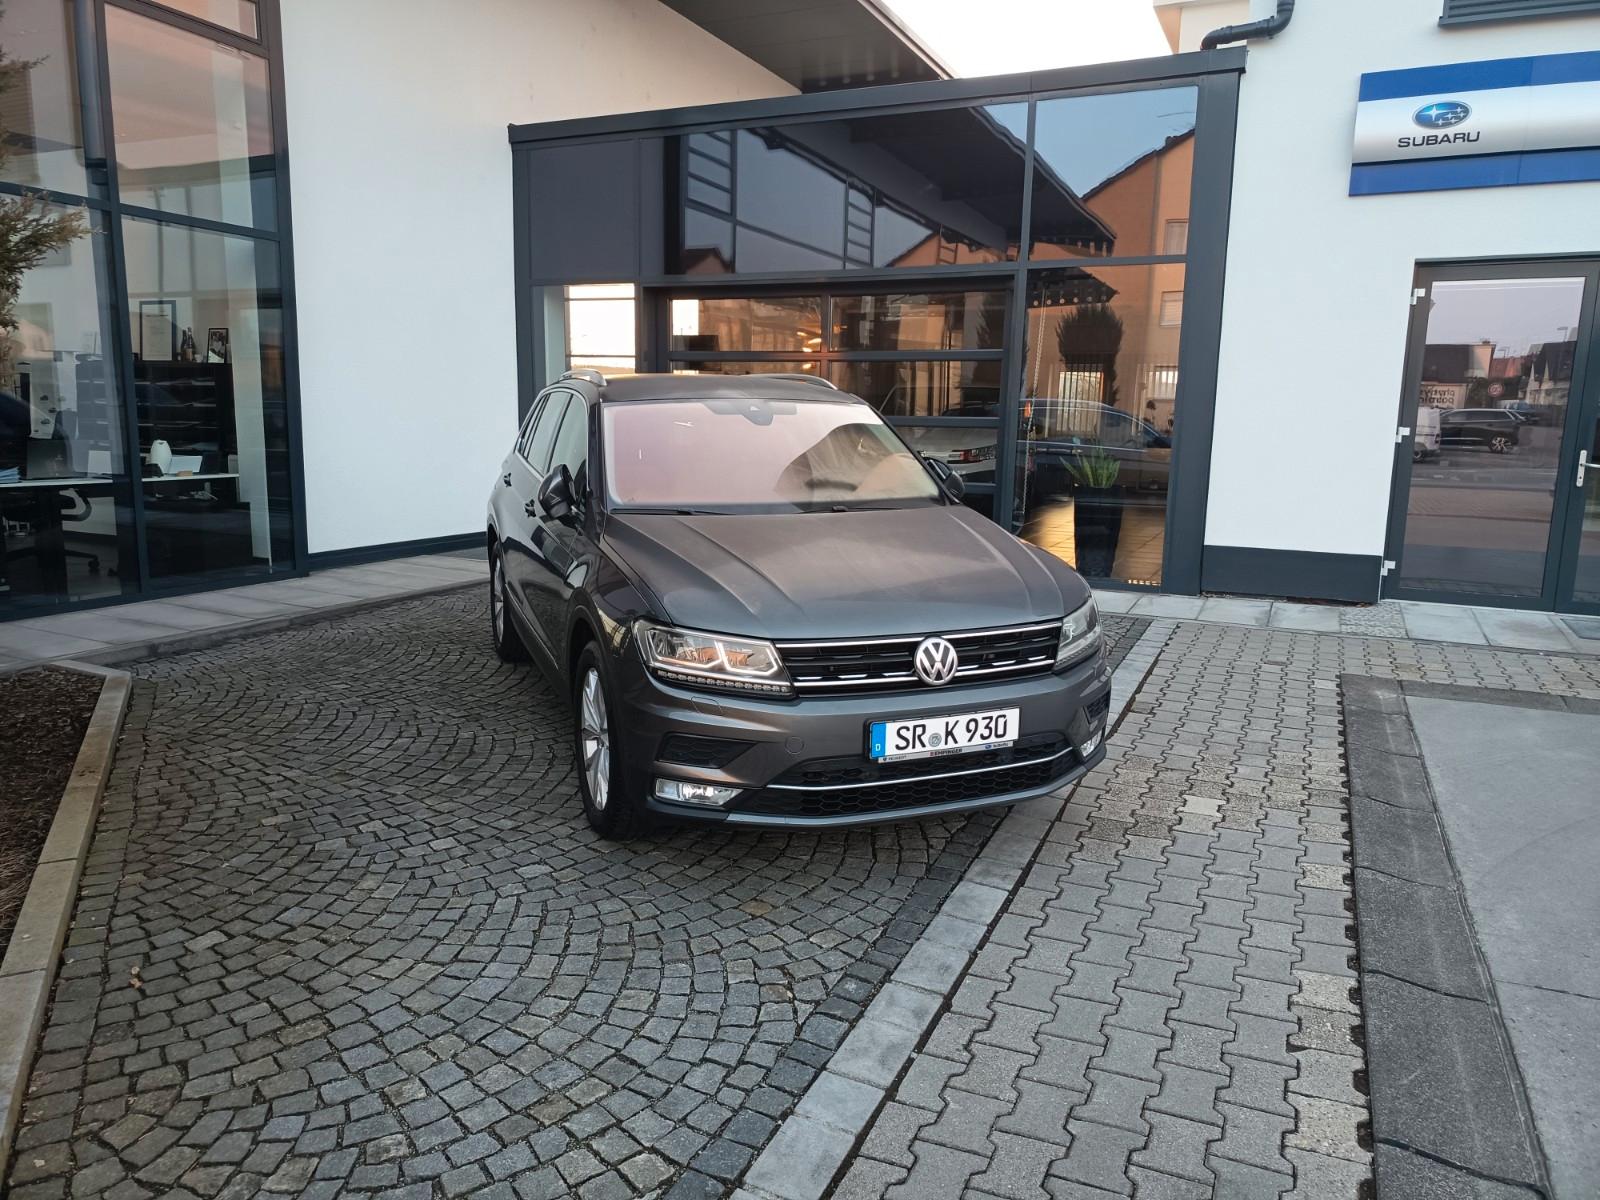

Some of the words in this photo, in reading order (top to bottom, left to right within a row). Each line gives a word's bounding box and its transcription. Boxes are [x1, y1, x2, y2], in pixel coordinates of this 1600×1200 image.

[1397, 131, 1480, 148] SUBARU
[895, 724, 927, 751] SR
[944, 720, 960, 746] K
[966, 714, 1007, 743] 930
